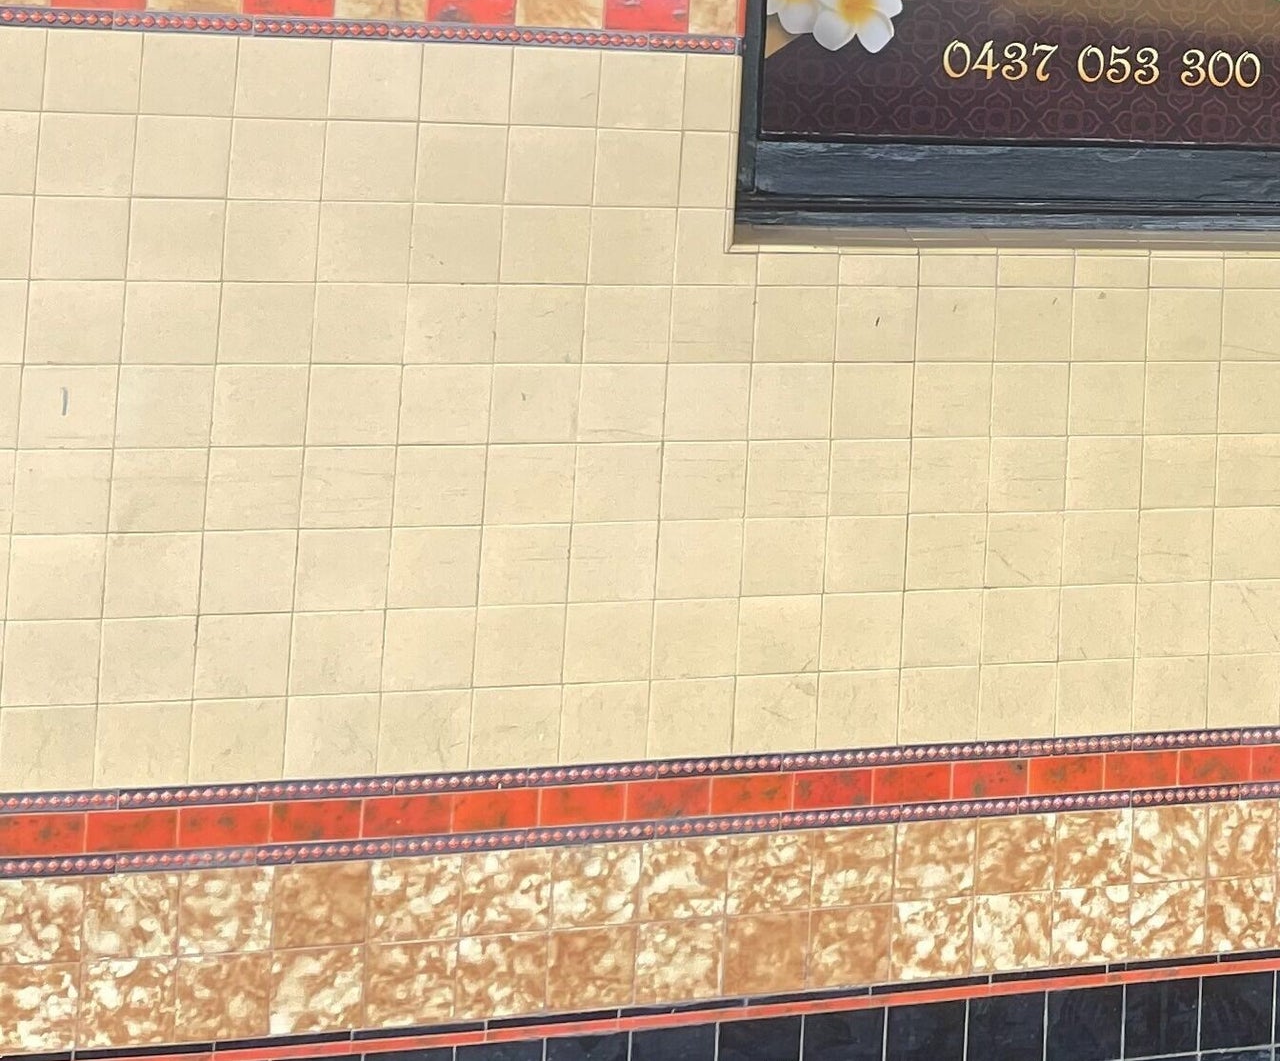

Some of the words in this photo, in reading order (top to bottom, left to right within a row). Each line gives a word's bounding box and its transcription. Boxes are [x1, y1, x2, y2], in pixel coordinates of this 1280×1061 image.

[942, 39, 1059, 81] 0437
[1077, 44, 1160, 85] 053
[1180, 49, 1261, 88] 300
